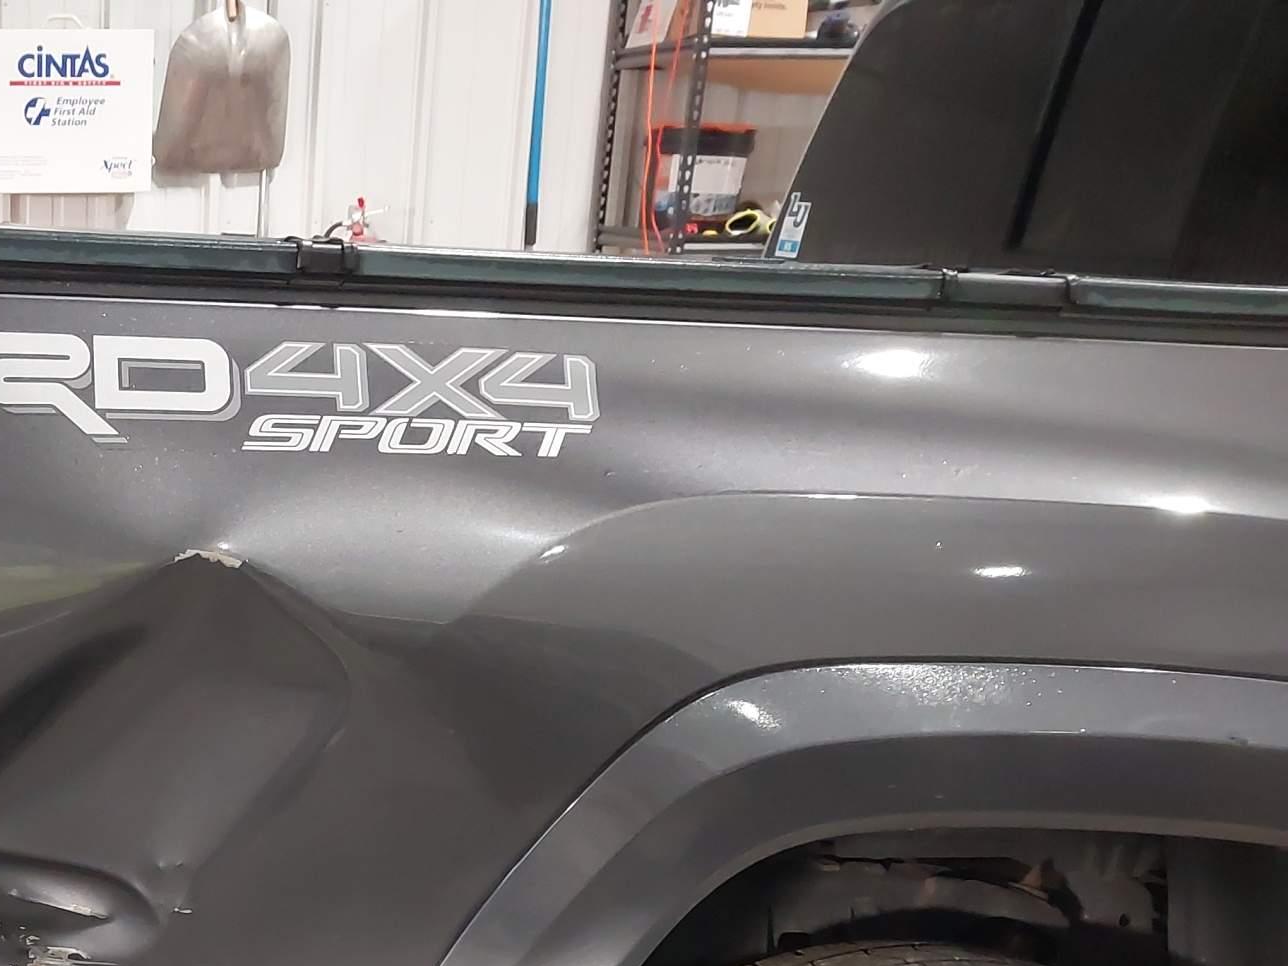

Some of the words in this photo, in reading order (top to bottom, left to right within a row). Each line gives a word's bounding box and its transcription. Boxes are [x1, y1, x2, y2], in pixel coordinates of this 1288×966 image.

[56, 96, 106, 107] Employee
[53, 107, 76, 116] First
[78, 106, 98, 116] Aid
[51, 118, 88, 127] Station
[242, 415, 592, 457] SPORT
